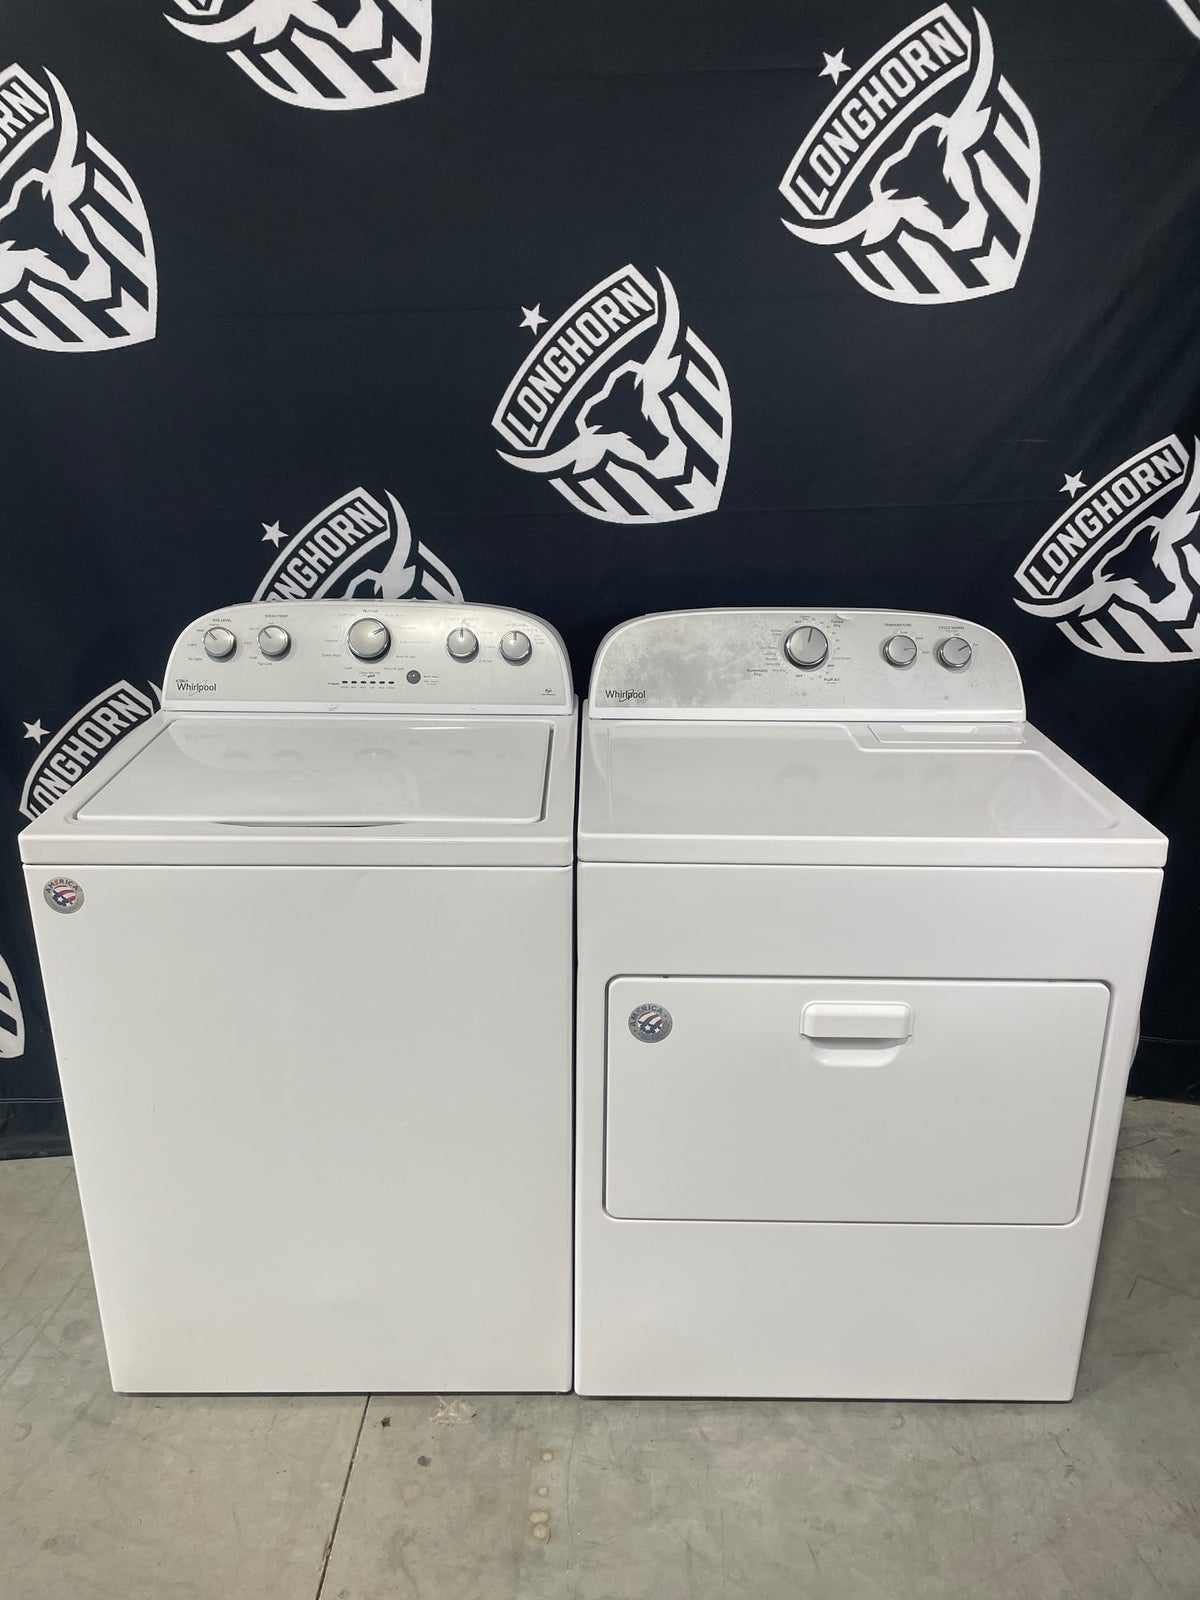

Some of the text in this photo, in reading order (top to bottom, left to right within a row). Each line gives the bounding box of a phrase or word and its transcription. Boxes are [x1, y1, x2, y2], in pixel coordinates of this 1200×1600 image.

[796, 22, 965, 211] LONGHORN
[506, 280, 653, 444] LONGHORN
[265, 501, 385, 600] NGHORN
[1029, 448, 1182, 593] LONGHORN
[177, 683, 217, 693] Whirlpool
[605, 690, 646, 700] Whirlpool
